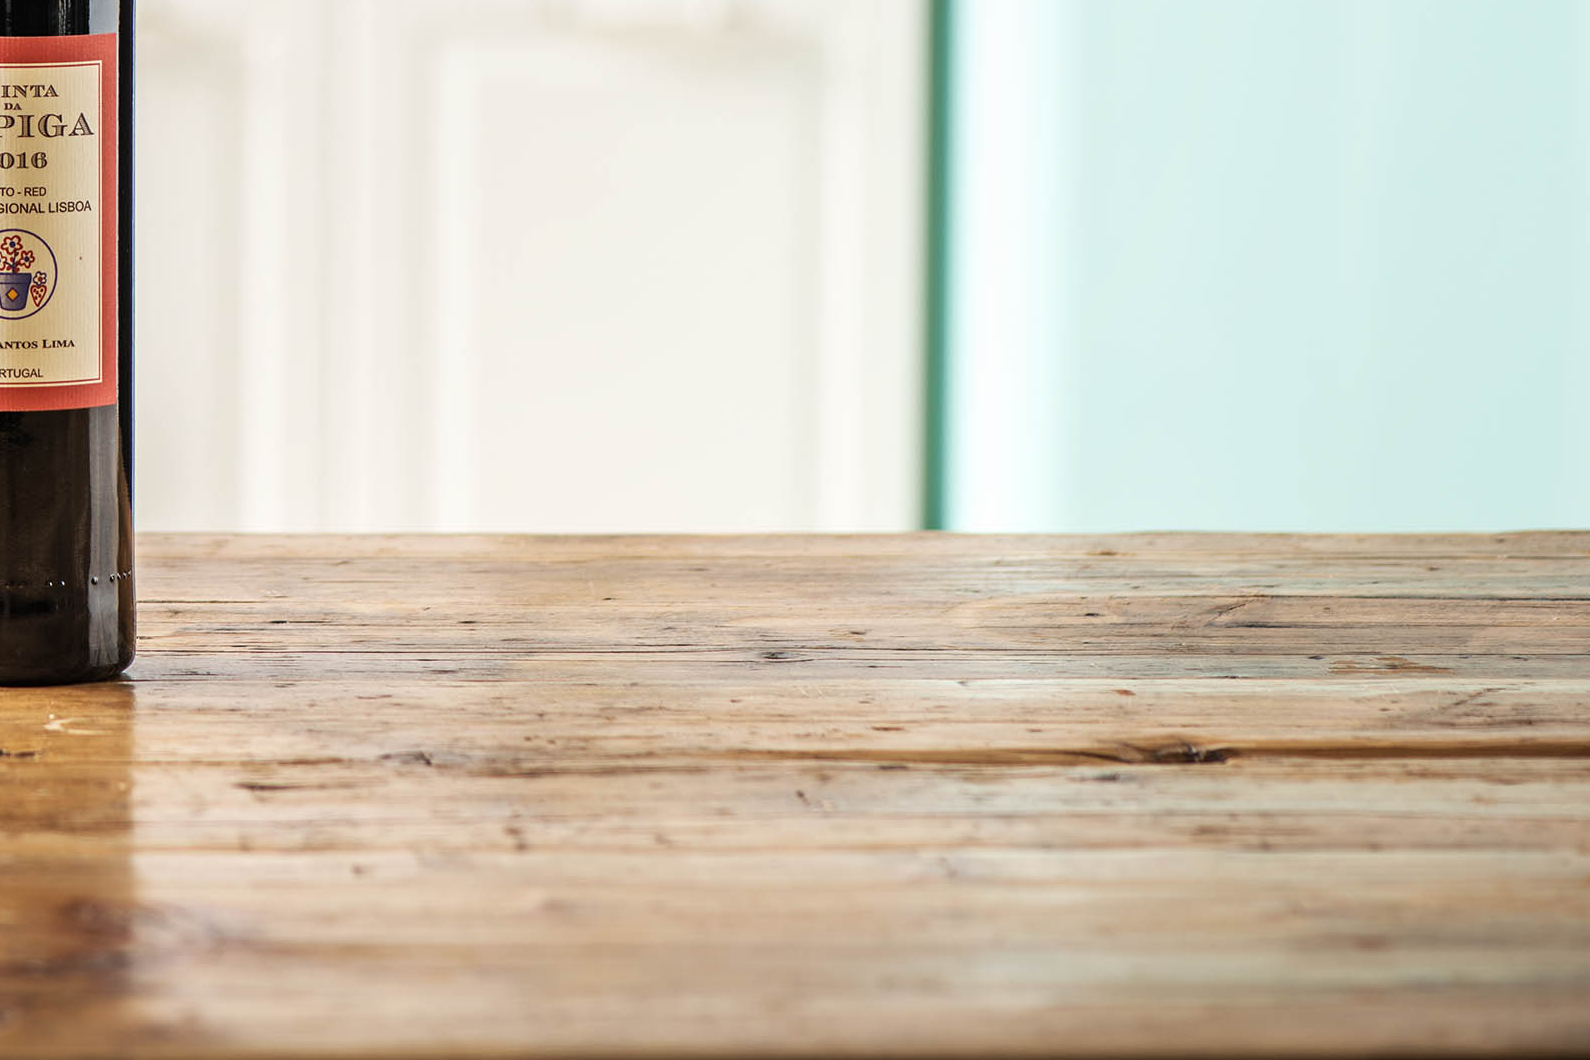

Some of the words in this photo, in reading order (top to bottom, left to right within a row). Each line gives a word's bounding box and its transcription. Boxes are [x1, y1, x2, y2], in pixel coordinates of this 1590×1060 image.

[4, 102, 22, 111] DA
[24, 187, 47, 197] RED
[48, 200, 92, 213] LISBOA
